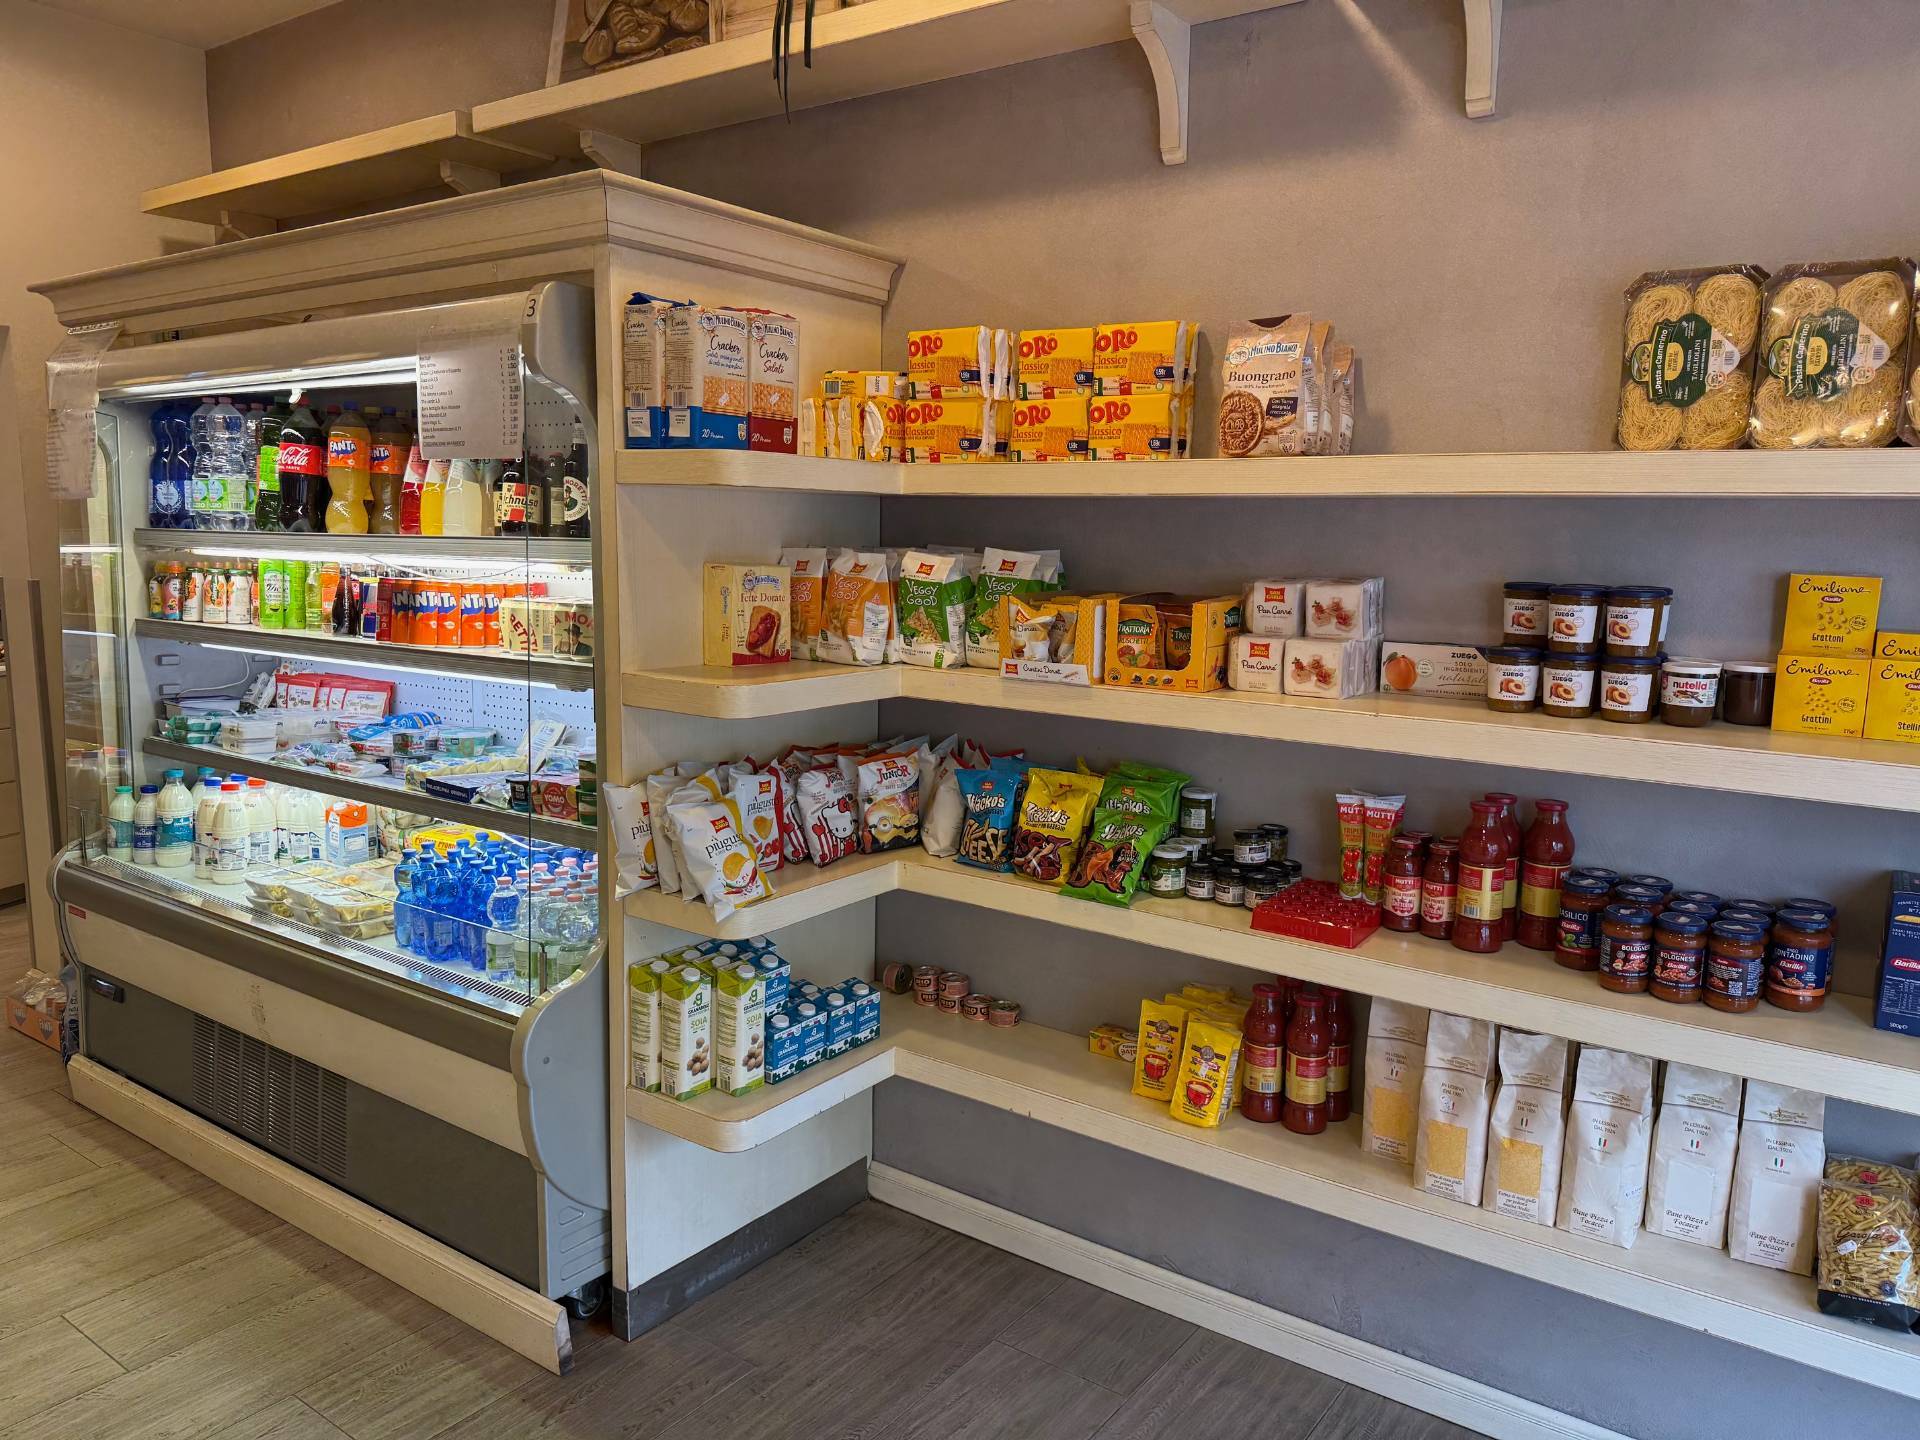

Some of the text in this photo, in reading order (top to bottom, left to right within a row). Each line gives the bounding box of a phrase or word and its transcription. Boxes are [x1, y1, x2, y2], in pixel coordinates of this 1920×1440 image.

[526, 298, 536, 318] 3
[710, 334, 742, 355] Cracker
[1018, 335, 1058, 359] ORO
[1094, 329, 1138, 353] ORO
[1655, 329, 1668, 364] Camerino
[1796, 323, 1811, 359] Camerino
[759, 342, 789, 362] Cracker
[909, 358, 936, 370] lassico
[1691, 339, 1702, 381] TAGLIOLINI
[1228, 370, 1296, 385] Buongrano
[1655, 369, 1663, 389] Pasta
[904, 402, 944, 425] ORO
[1013, 404, 1052, 427] ORO
[1089, 400, 1132, 424] ORO
[329, 440, 357, 452] FANTA
[372, 447, 390, 458] NTA
[834, 574, 864, 590] VEGGY
[905, 579, 939, 596] VEGGY
[985, 576, 1018, 595] VEGGY
[1798, 577, 1871, 595] Emiliane
[741, 592, 786, 603] Fette Dorate
[906, 594, 938, 606] GOOD
[984, 589, 1001, 602] GO
[1256, 604, 1293, 616] Pan Carré
[1118, 623, 1150, 635] TRATTORIA
[1811, 632, 1845, 644] Grattoni
[1451, 652, 1478, 660] ZUEGG
[1241, 659, 1277, 672] Pan Carré
[1785, 659, 1859, 677] Emiliane
[1880, 663, 1920, 681] Emil
[1551, 675, 1573, 683] ZUEGG
[1673, 679, 1708, 691] nutella
[1801, 713, 1832, 725] Grattini
[876, 764, 911, 785] JUNIOR
[544, 793, 565, 805] YOMO
[1366, 809, 1395, 820] MUTTI
[1395, 878, 1414, 886] MUTTI
[1621, 944, 1651, 952] BOLOGNE
[1660, 951, 1696, 962] BOLOGNESE
[1666, 961, 1688, 971] Barilla
[1779, 960, 1805, 971] Barilla
[1894, 958, 1920, 970] Barilla
[690, 1016, 708, 1029] SOIA
[746, 1012, 763, 1025] SOIA
[1572, 1207, 1589, 1219] Pane
[1590, 1213, 1609, 1224] Pizza
[1665, 1209, 1683, 1219] Pane
[1684, 1214, 1704, 1225] Pizza
[1579, 1217, 1605, 1229] Focacce
[1673, 1218, 1700, 1230] Focacce
[1749, 1231, 1768, 1242] Pane
[1768, 1236, 1789, 1247] Pizza
[1757, 1240, 1785, 1253] Focacce
